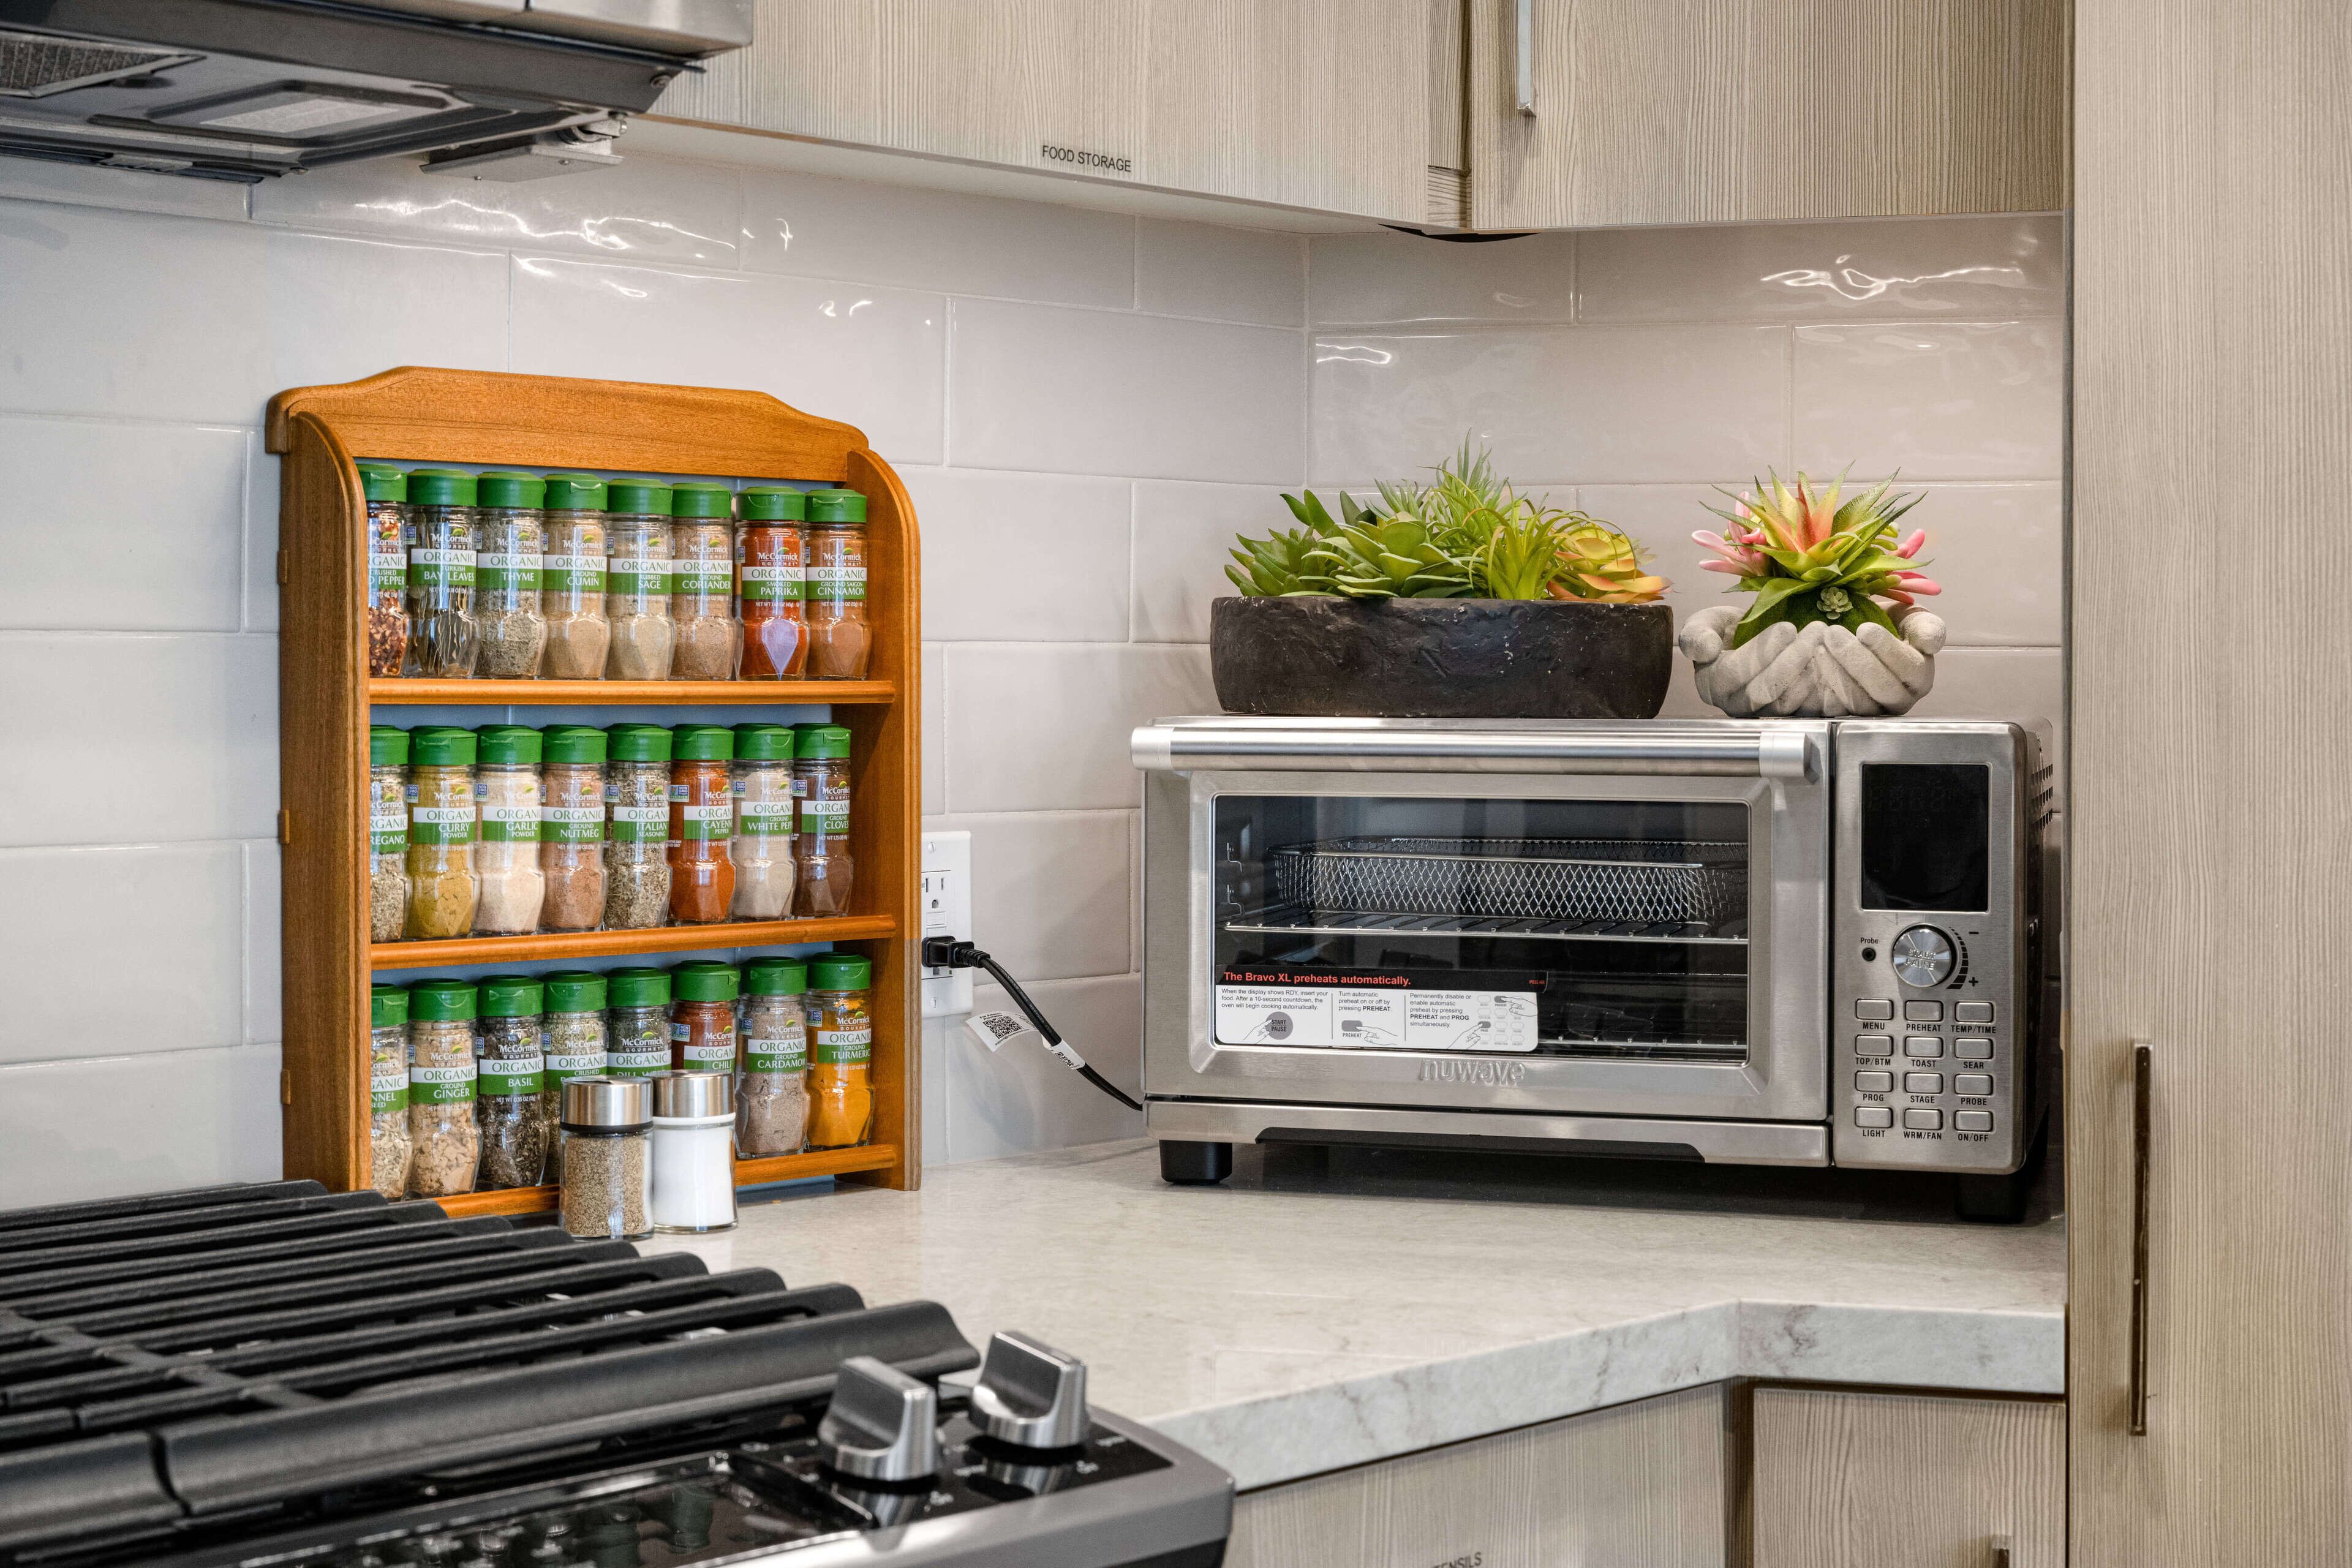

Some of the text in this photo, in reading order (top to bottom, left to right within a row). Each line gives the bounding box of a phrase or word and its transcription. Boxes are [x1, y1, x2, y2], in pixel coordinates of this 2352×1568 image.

[1042, 145, 1131, 173] FOOD STORAGE
[368, 556, 405, 567] GANIC
[424, 551, 475, 564] ORGANIC
[491, 556, 542, 567] ORGANIC
[757, 552, 797, 562] McCormick
[823, 552, 861, 562] McCormick
[556, 557, 605, 568] ORGANIC
[622, 560, 671, 572] ORGANIC
[684, 562, 731, 572] ORGANIC
[424, 571, 474, 581] BAY LEAVES
[502, 571, 535, 582] THYME
[752, 568, 802, 579] ORGANIC
[818, 569, 865, 579] ORGANIC
[567, 577, 599, 586] CUMIN
[638, 580, 662, 589] SAGE
[760, 587, 798, 596] PAPRIKA
[818, 587, 865, 595] CINNAMON
[426, 810, 476, 821] ORGANIC
[553, 809, 603, 820] ORGANIC
[371, 818, 407, 829] RGANIC
[439, 823, 470, 832] CURRY
[506, 821, 538, 831] GARLIC
[636, 822, 666, 831] ITALIAN
[748, 822, 778, 831] WHITE
[560, 829, 600, 838] NUTMEG
[371, 834, 405, 845] REGANO
[1908, 949, 1937, 959] START
[1905, 959, 1936, 970] PAUSE
[1224, 972, 1411, 987] The Bravo XL preheats automatically.
[837, 1016, 870, 1025] McCormick
[1906, 1023, 1942, 1032] PREHEAT
[1951, 1025, 1997, 1034] TEMP/TIME
[621, 1036, 664, 1046] McCormick
[760, 1040, 805, 1052] ORGANIC
[500, 1043, 539, 1053] McCormick
[616, 1052, 668, 1066] ORGANIC
[831, 1049, 871, 1059] TURMERIC
[492, 1060, 542, 1072] ORGANIC
[559, 1055, 606, 1068] ORGANIC
[1855, 1057, 1891, 1066] TOP/BTM
[424, 1067, 475, 1080] ORGANIC
[371, 1077, 403, 1088] ANIC
[508, 1077, 533, 1087] BASIL
[371, 1092, 397, 1102] NNEL
[434, 1088, 470, 1098] GINGER
[1903, 1131, 1942, 1140] WRM/FAN
